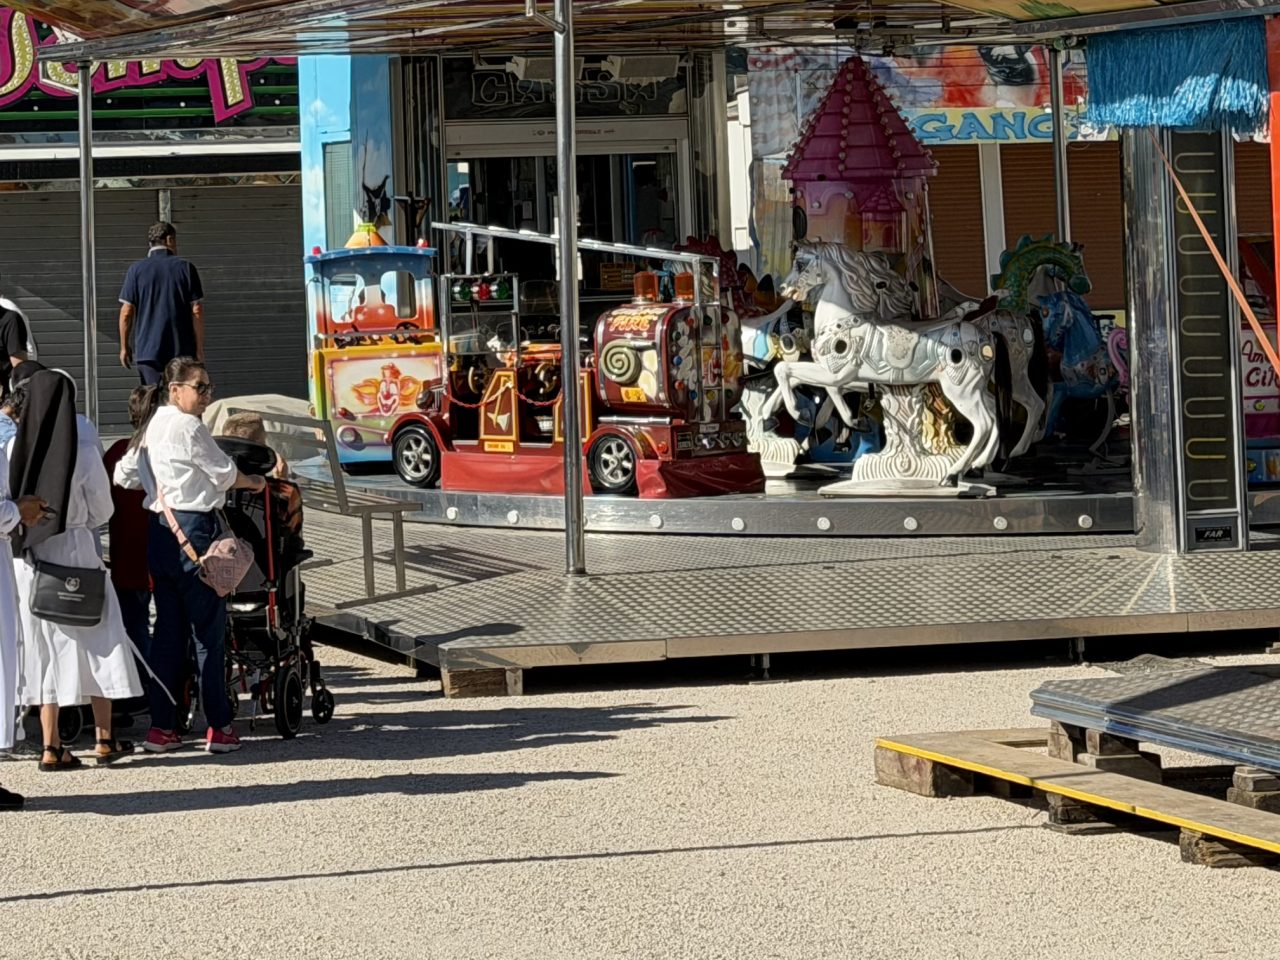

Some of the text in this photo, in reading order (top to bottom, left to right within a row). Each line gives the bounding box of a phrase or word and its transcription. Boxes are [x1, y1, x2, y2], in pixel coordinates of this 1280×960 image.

[471, 69, 657, 106] CASA
[1242, 340, 1270, 363] Am
[1204, 530, 1224, 538] FAR
